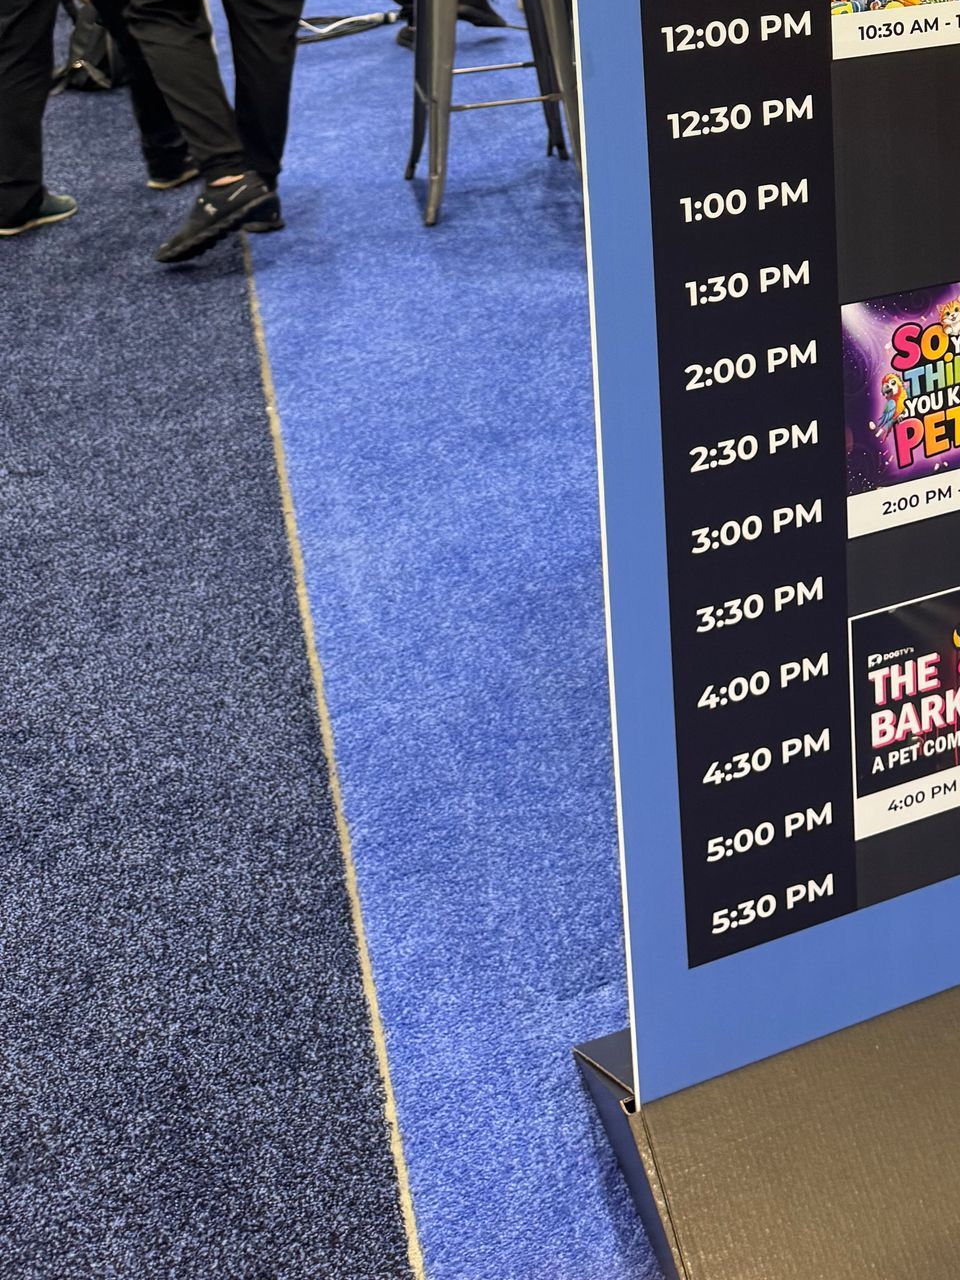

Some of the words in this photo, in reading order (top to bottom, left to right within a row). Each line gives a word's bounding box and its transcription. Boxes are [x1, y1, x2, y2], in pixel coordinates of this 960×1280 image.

[661, 18, 749, 52] 12:00
[761, 11, 812, 41] PM
[858, 22, 905, 42] 10:30
[909, 16, 939, 36] AM
[667, 104, 751, 139] 12:30
[763, 95, 813, 125] PM
[680, 189, 746, 222] 1:00
[758, 179, 809, 210] PM
[685, 272, 749, 306] 1:30
[760, 260, 810, 293] PM
[685, 354, 756, 390] 2:00
[768, 340, 817, 373] PM
[891, 320, 949, 370] SO
[904, 391, 944, 418] YOU
[690, 435, 758, 472] 2:30
[769, 420, 818, 454] PM
[882, 494, 920, 516] 2:00
[925, 485, 952, 505] PM
[692, 516, 762, 554] 3:00
[773, 499, 822, 533] PM
[697, 594, 764, 633] 3:30
[775, 577, 824, 612] PM
[698, 670, 769, 709] 4:00
[781, 653, 829, 688] PM
[868, 652, 941, 706] THE
[703, 748, 771, 785] 4:30
[782, 728, 830, 763] PM
[871, 756, 885, 775] A
[888, 745, 920, 770] PET
[887, 790, 926, 813] 4:00
[931, 779, 958, 799] PM
[707, 821, 774, 861] 5:00
[785, 802, 832, 837] PM
[712, 895, 776, 935] 5:30
[787, 874, 834, 910] PM
